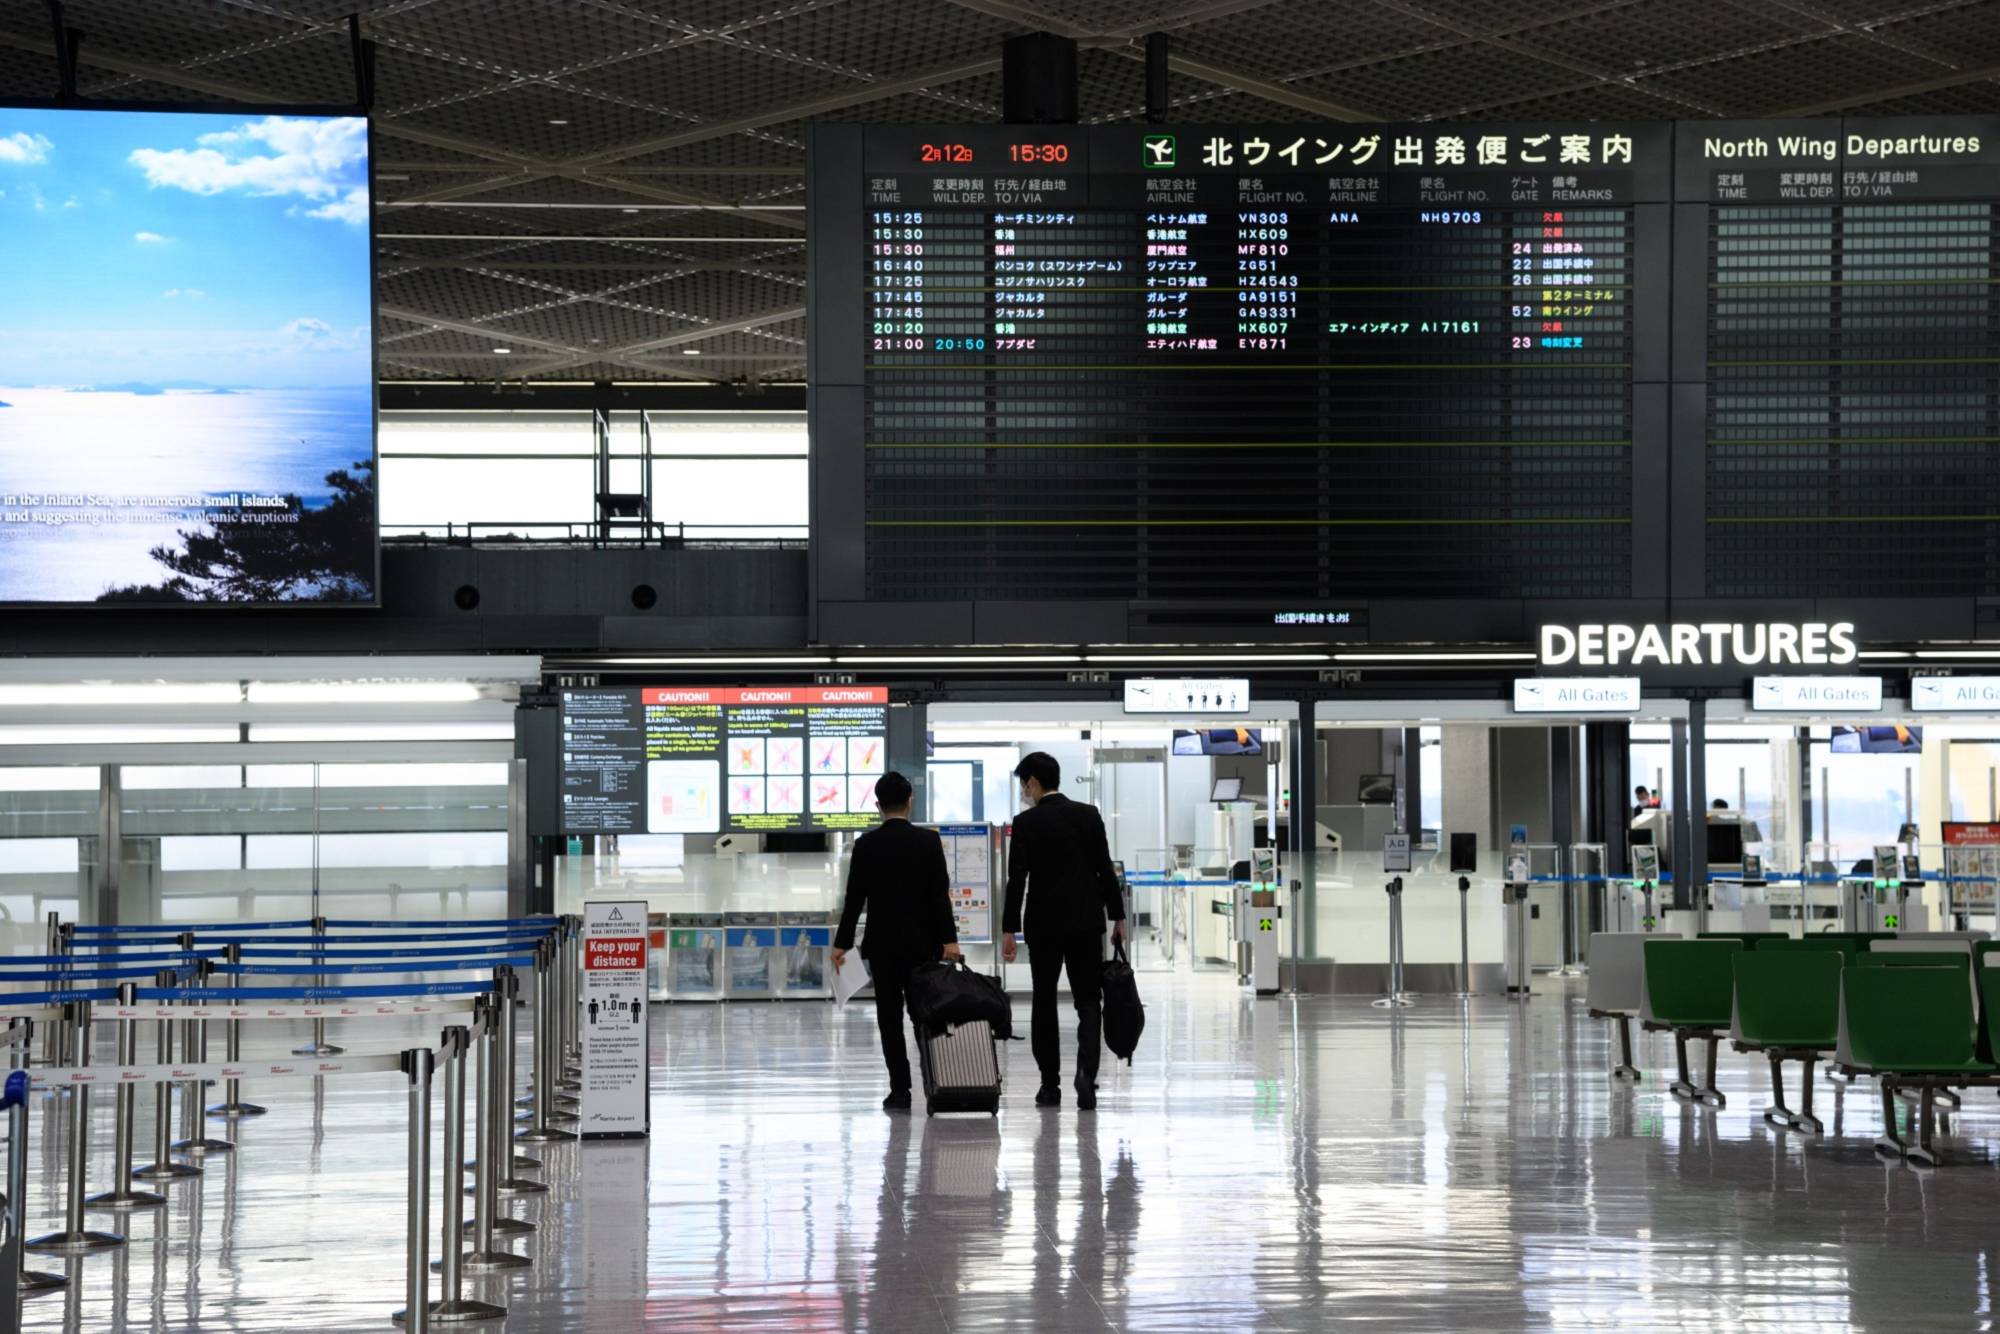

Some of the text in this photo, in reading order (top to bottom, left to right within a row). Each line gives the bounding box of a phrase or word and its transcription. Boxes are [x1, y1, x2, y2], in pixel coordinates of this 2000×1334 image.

[921, 144, 1068, 162] 2月12日 15:30
[1704, 135, 1980, 160] North Wing Departures
[872, 179, 897, 190] 定刻
[932, 178, 984, 190] 変更時刻
[1146, 179, 1196, 190] 航空会社
[1238, 178, 1263, 190] 便名
[1329, 178, 1379, 190] 航空会社
[1420, 178, 1444, 190] 便名
[1512, 177, 1538, 188] ゲート
[1552, 176, 1578, 188] 備考
[1718, 174, 1744, 186] 定刻
[1780, 172, 1832, 186] 変更時刻
[872, 192, 900, 203] TIME
[933, 192, 959, 203] WILL
[995, 192, 1011, 203] TO
[1022, 192, 1042, 203] VIA
[1147, 192, 1194, 202] AIRLINE
[1240, 192, 1282, 202] FLIGHT
[1330, 192, 1376, 202] AIRLINE
[1421, 191, 1464, 201] FLIGHT
[1512, 190, 1538, 200] GATE
[1553, 190, 1612, 200] REMARKS
[1718, 187, 1747, 198] TIME
[1780, 186, 1806, 198] WILL
[1844, 186, 1860, 196] TO
[1872, 186, 1892, 196] VIA
[874, 213, 922, 224] 15:25
[994, 214, 1074, 224] ホーチミンシティ
[1238, 213, 1288, 224] VN303
[1330, 212, 1359, 223] ANA
[1421, 212, 1481, 223] NH9703
[874, 229, 922, 240] 15:30
[1238, 228, 1288, 240] HX609
[874, 244, 923, 255] 15:30
[1238, 244, 1288, 256] MF810
[1512, 243, 1532, 254] 24
[874, 260, 923, 271] 16:40
[1239, 260, 1276, 270] ZG51
[1512, 258, 1532, 270] 22
[874, 276, 922, 287] 17:25
[994, 277, 1086, 287] ユジノサハリンスク
[1238, 276, 1298, 286] HZ4543
[1512, 274, 1532, 285] 26
[874, 292, 923, 302] 17:45
[995, 292, 1045, 302] ジャカルタ
[1147, 292, 1188, 302] ガルーダ
[1238, 292, 1296, 302] GA9151
[874, 308, 923, 318] 17:45
[995, 308, 1045, 318] ジャカルタ
[1147, 308, 1188, 318] ガルーダ
[1238, 308, 1296, 318] GA9331
[1512, 306, 1532, 317] 52
[874, 323, 924, 334] 20:20
[1238, 323, 1288, 334] HX607
[874, 339, 924, 350] 21:00
[935, 339, 984, 350] 20:50
[1238, 338, 1286, 350] EY871
[1512, 338, 1531, 348] 23
[4, 494, 16, 506] in
[20, 493, 40, 506] the
[44, 493, 84, 506] Inland
[118, 496, 137, 506] are
[140, 496, 202, 506] numerous
[206, 494, 238, 506] small
[242, 494, 288, 508] islands,
[4, 510, 298, 525] and suggesting the immense volcanic eruptions
[1540, 622, 1858, 665] DEPARTURES
[658, 692, 710, 702] CAUTION!!
[740, 692, 792, 701] CAUTION!!
[822, 691, 873, 700] CAUTION!!
[1558, 688, 1628, 702] All Gates
[1798, 686, 1869, 700] All Gates
[1957, 686, 1976, 700] All
[590, 941, 641, 954] Keep your
[593, 955, 637, 966] distance
